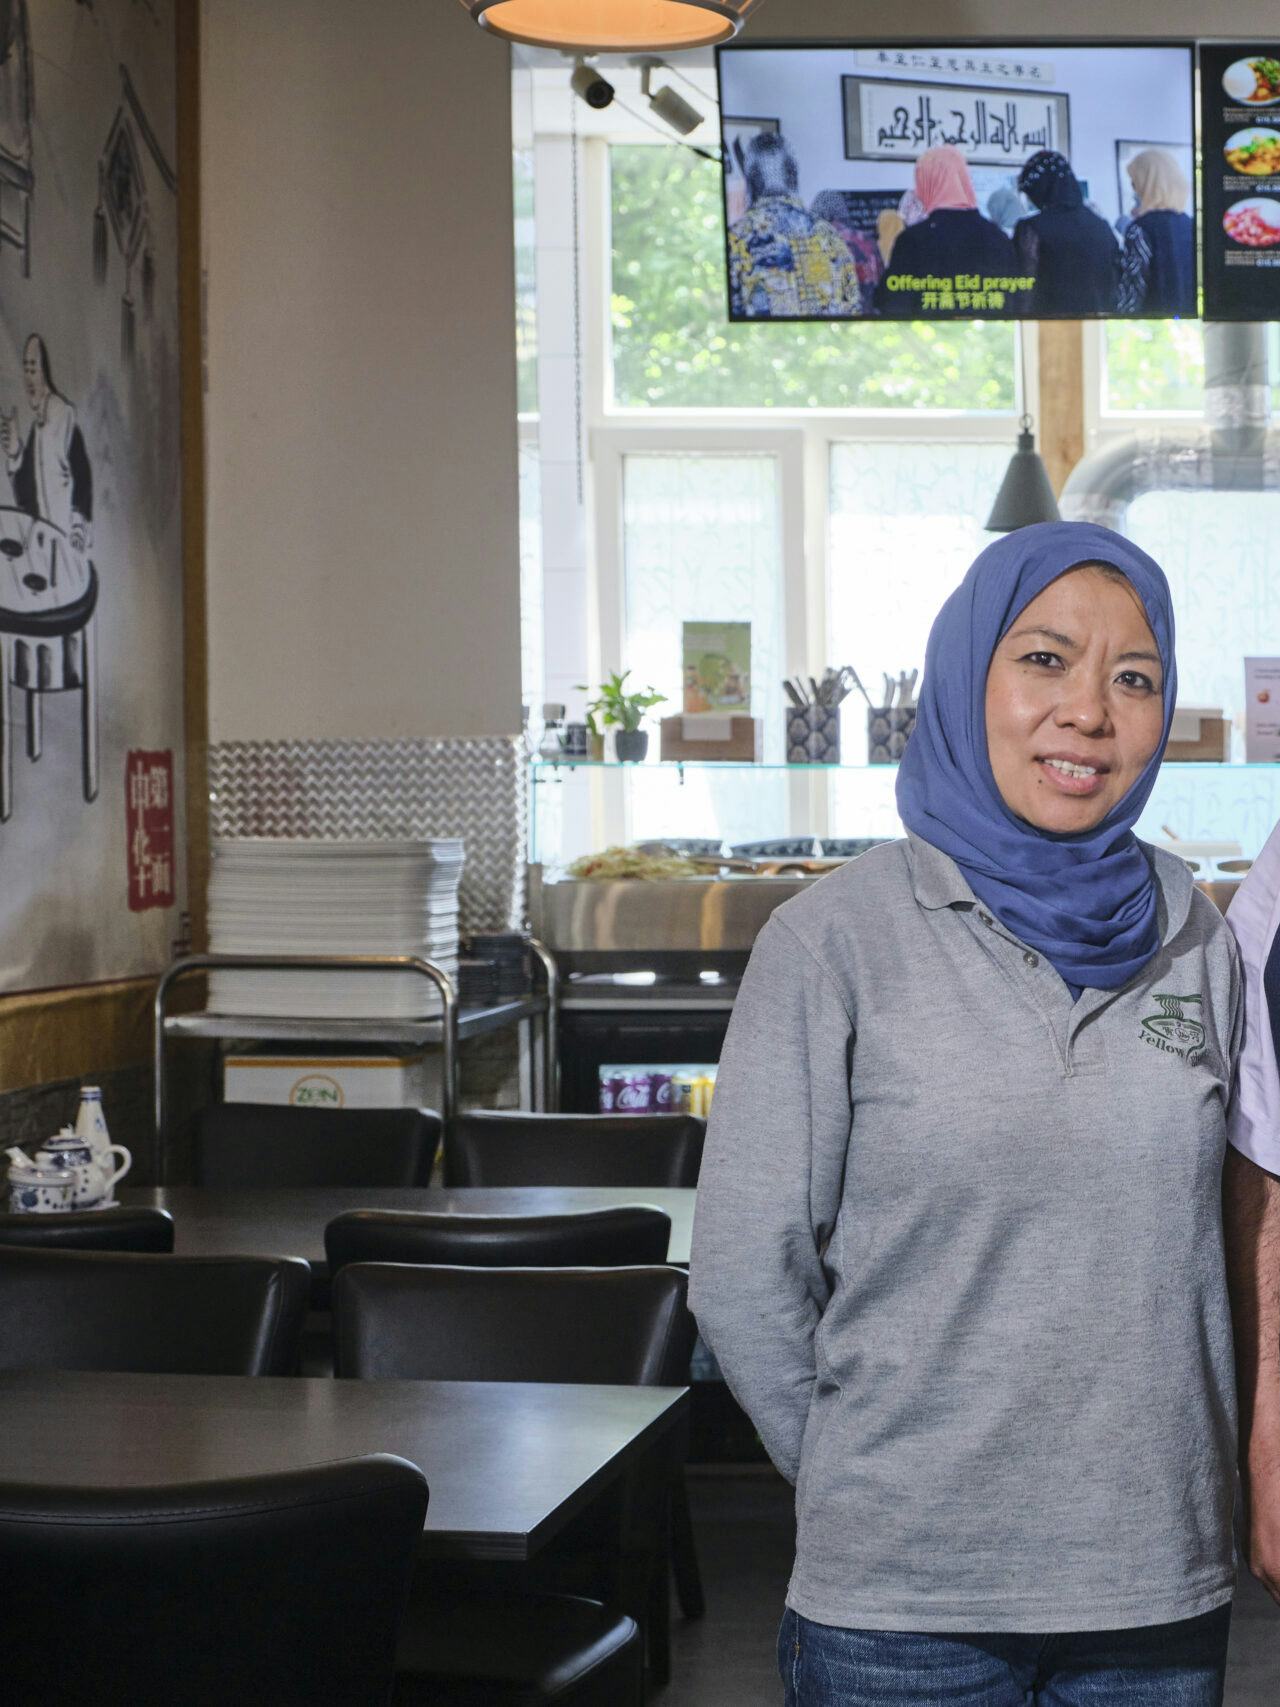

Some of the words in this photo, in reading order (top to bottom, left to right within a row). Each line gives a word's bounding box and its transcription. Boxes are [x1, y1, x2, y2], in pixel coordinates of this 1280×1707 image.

[886, 275, 953, 292] Offering
[955, 274, 980, 290] Eid
[983, 276, 1035, 293] prayer
[1137, 1028, 1185, 1058] Yellow
